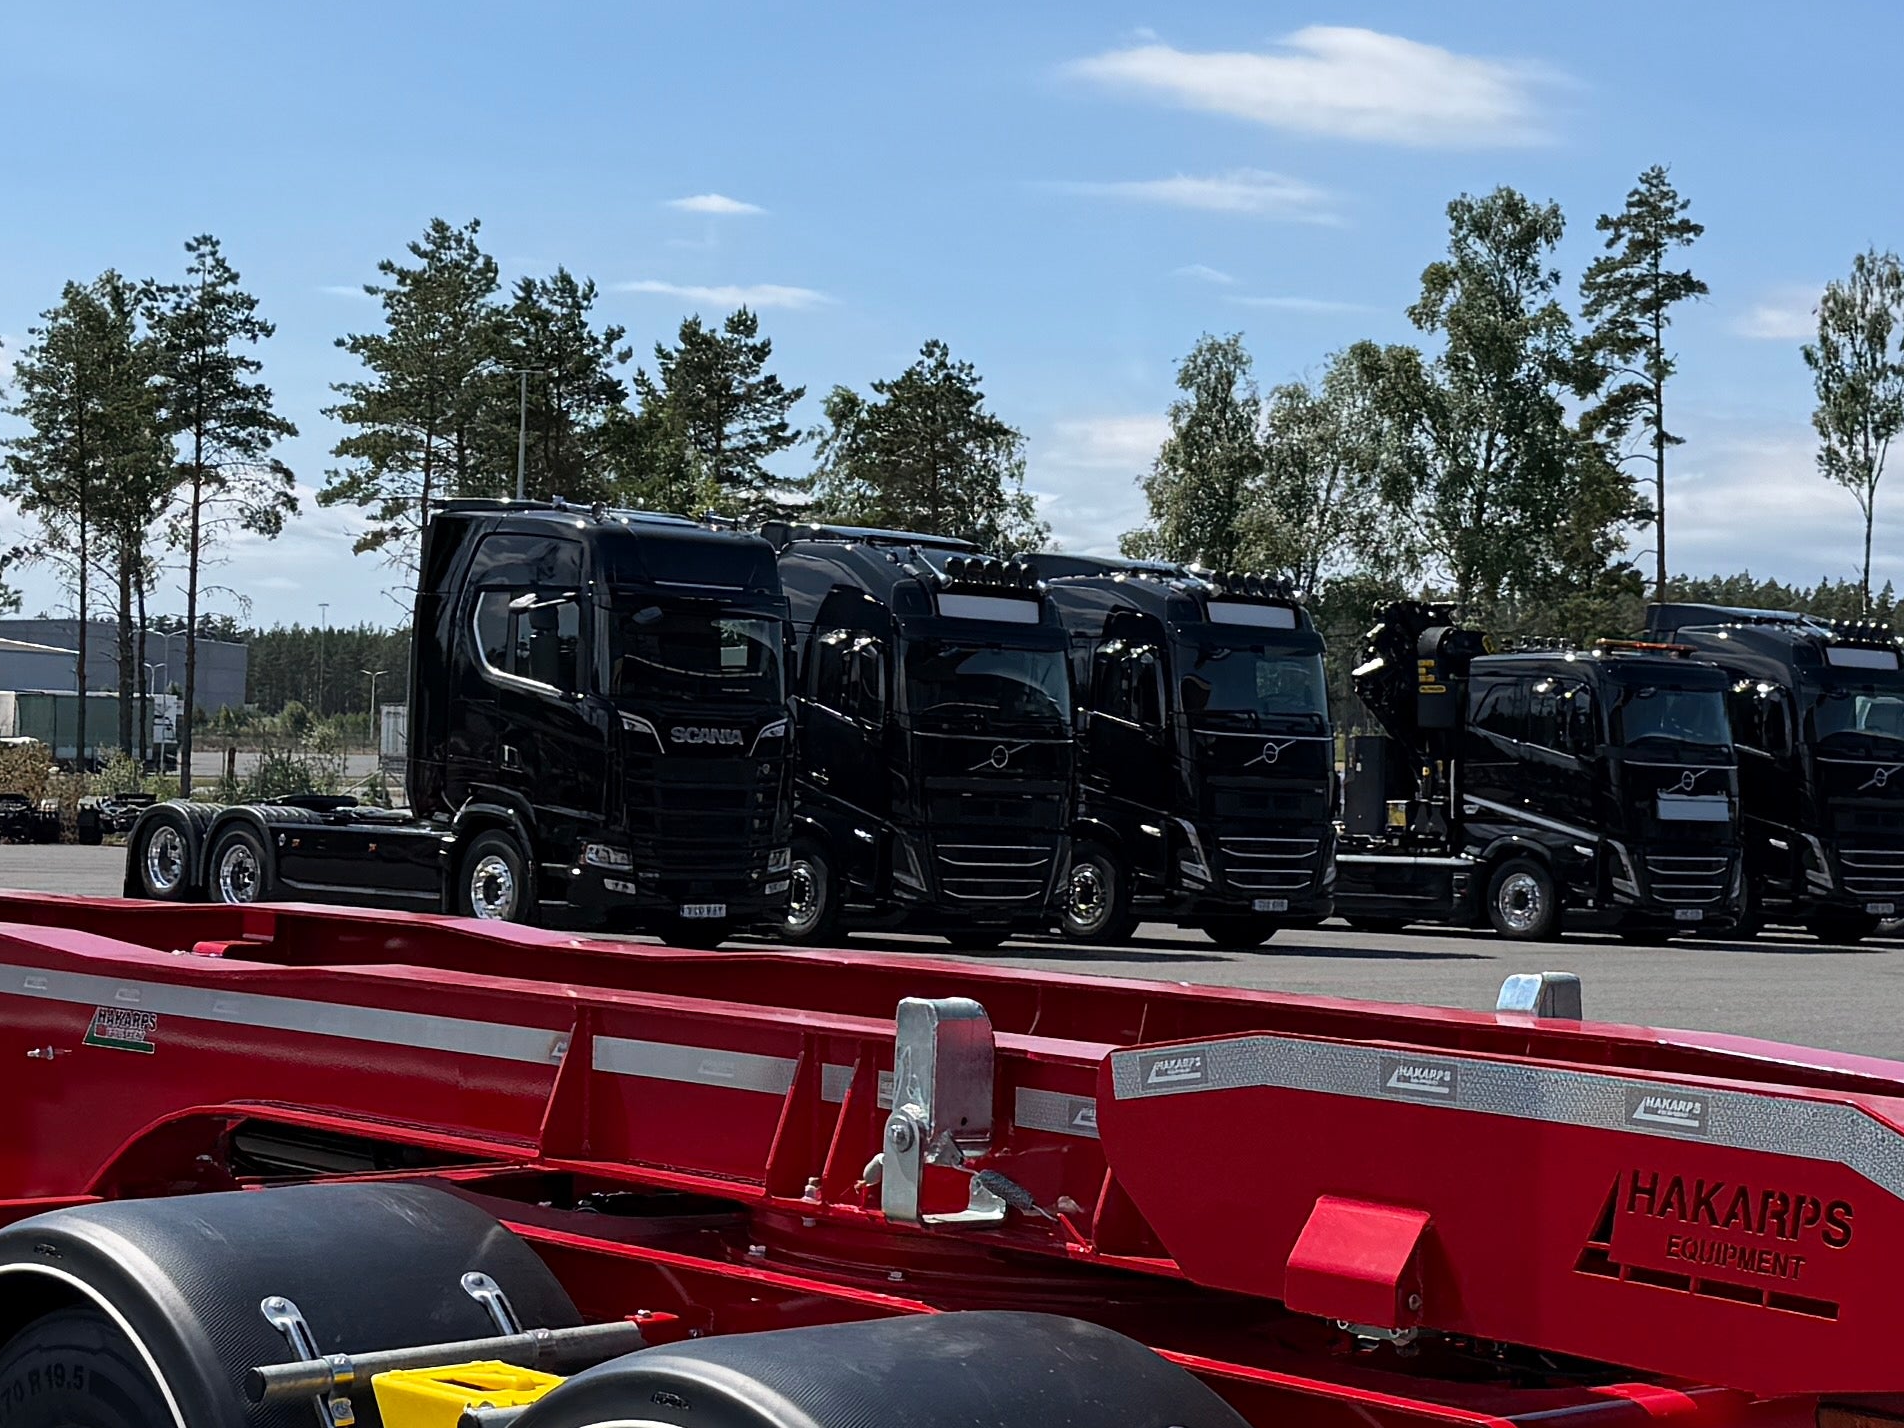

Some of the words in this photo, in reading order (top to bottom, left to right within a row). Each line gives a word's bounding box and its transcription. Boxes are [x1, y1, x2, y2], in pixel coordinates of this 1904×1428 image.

[671, 726, 744, 746] SCANIA
[97, 1006, 158, 1032] HAKARPS
[1644, 1095, 1702, 1115] HAKARPS
[1625, 1169, 1855, 1250] HAKARPS
[1665, 1235, 1807, 1280] EQUIPMENT
